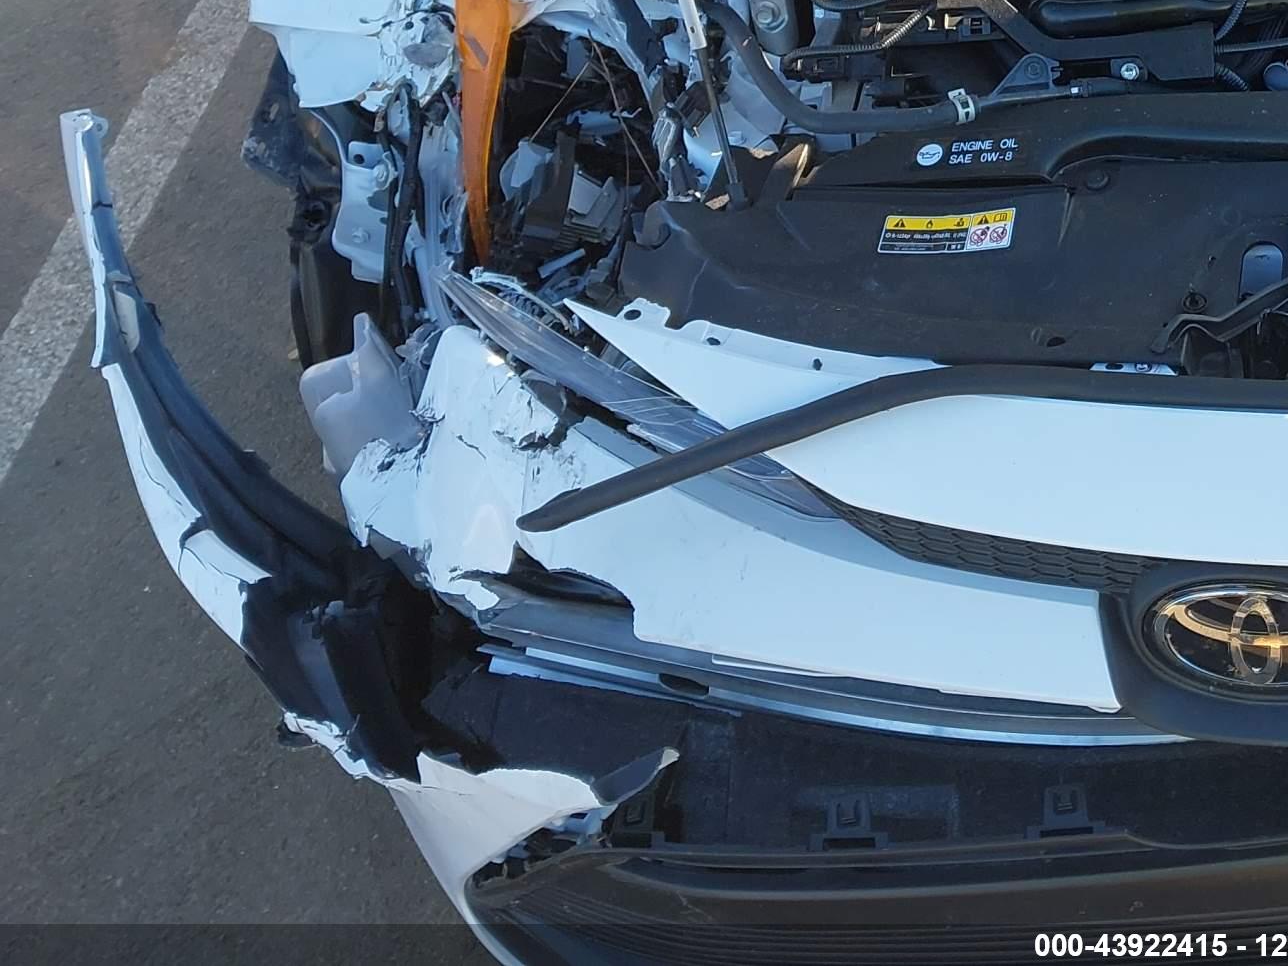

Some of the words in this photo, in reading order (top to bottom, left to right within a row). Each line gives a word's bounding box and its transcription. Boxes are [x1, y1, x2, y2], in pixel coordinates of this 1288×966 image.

[951, 140, 994, 153] ENGINE
[1000, 137, 1018, 149] OIL
[948, 153, 973, 165] SAE
[980, 151, 1013, 163] 0W-8
